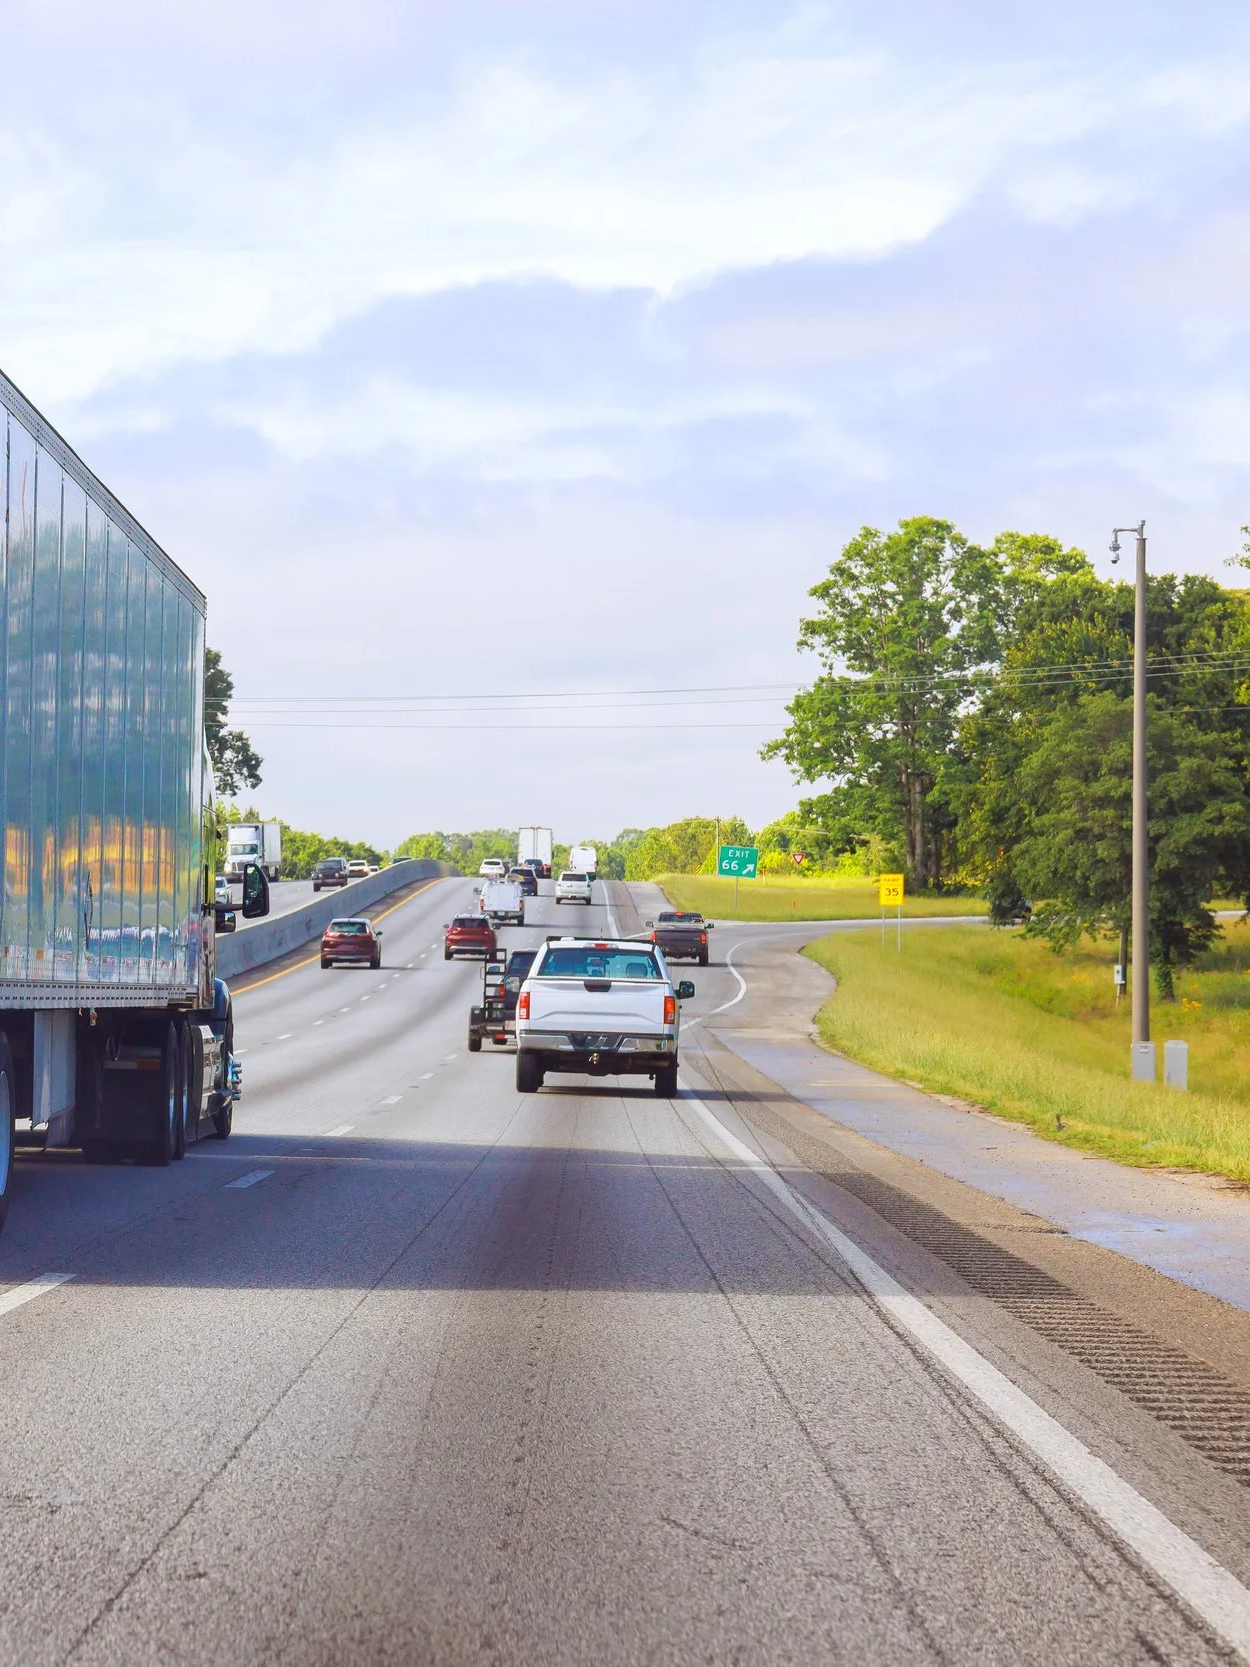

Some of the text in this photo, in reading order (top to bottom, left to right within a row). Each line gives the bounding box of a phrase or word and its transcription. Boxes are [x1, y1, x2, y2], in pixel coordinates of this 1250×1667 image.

[728, 849, 750, 858] EXIT
[722, 859, 739, 870] 66
[885, 887, 899, 897] 35
